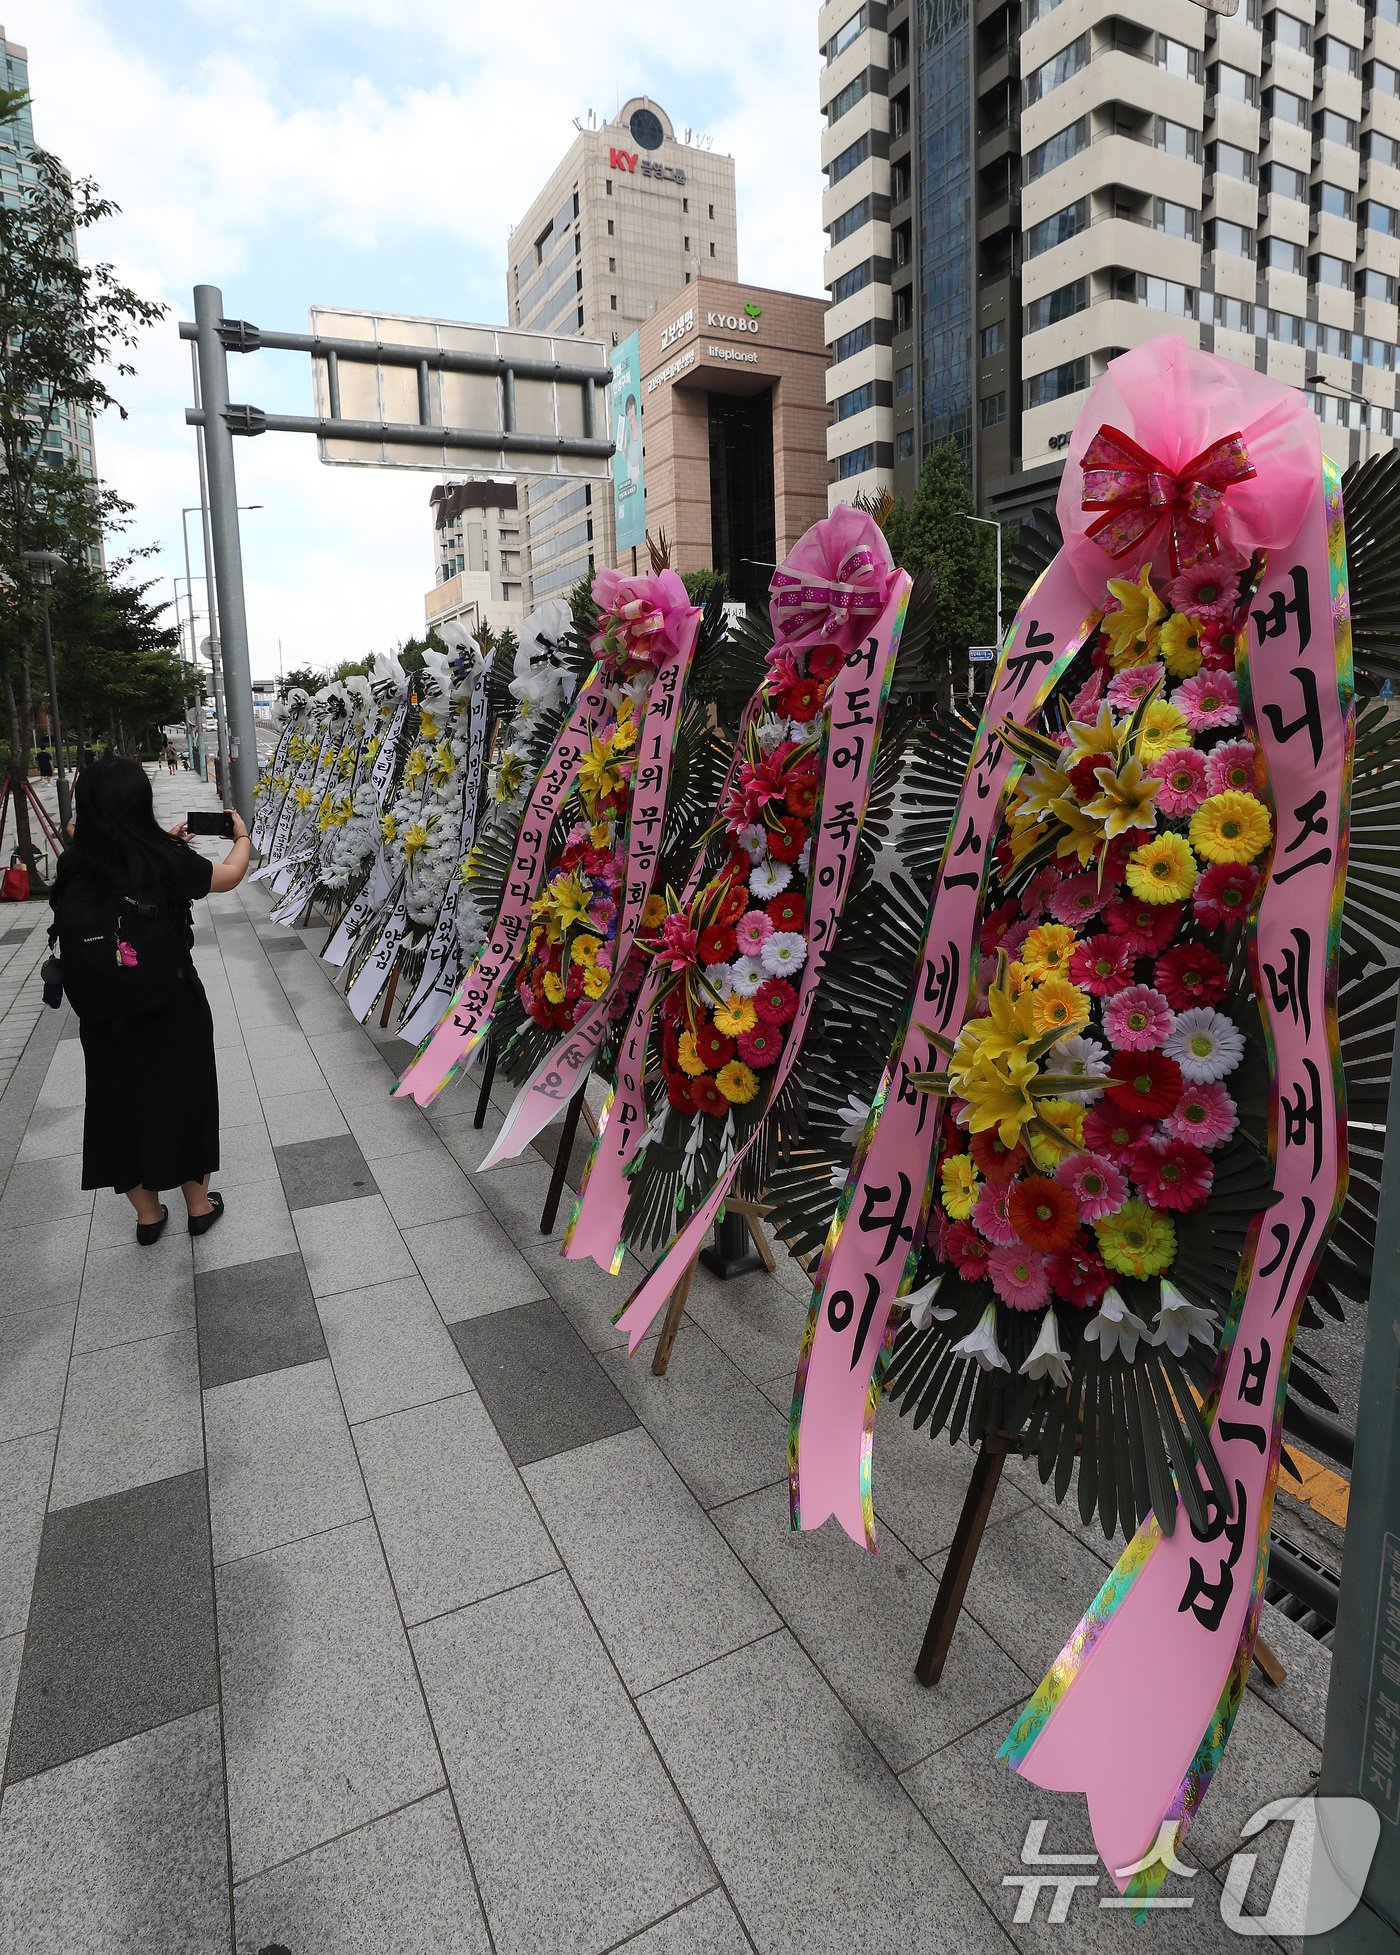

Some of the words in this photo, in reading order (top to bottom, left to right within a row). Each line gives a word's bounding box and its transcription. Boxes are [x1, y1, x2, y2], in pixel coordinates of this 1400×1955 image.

[609, 147, 638, 174] KY
[660, 308, 694, 352] 교보생명
[707, 312, 759, 333] KYOBO
[708, 345, 758, 363] lifeplanet
[472, 675, 487, 719] 이미
[647, 664, 680, 721] 업계
[831, 637, 879, 783] 어도어
[942, 619, 1054, 893] 뉴진스
[1250, 564, 1332, 886] 버니즈
[530, 746, 583, 820] 양심은
[637, 734, 663, 794] 1위
[510, 828, 542, 906] 어디다
[629, 805, 661, 871] 무능
[811, 800, 858, 952] 죽이기
[621, 881, 647, 939] 회사
[372, 928, 403, 970] 양심
[617, 1008, 645, 1157] stop!
[826, 1170, 913, 1373] 다이
